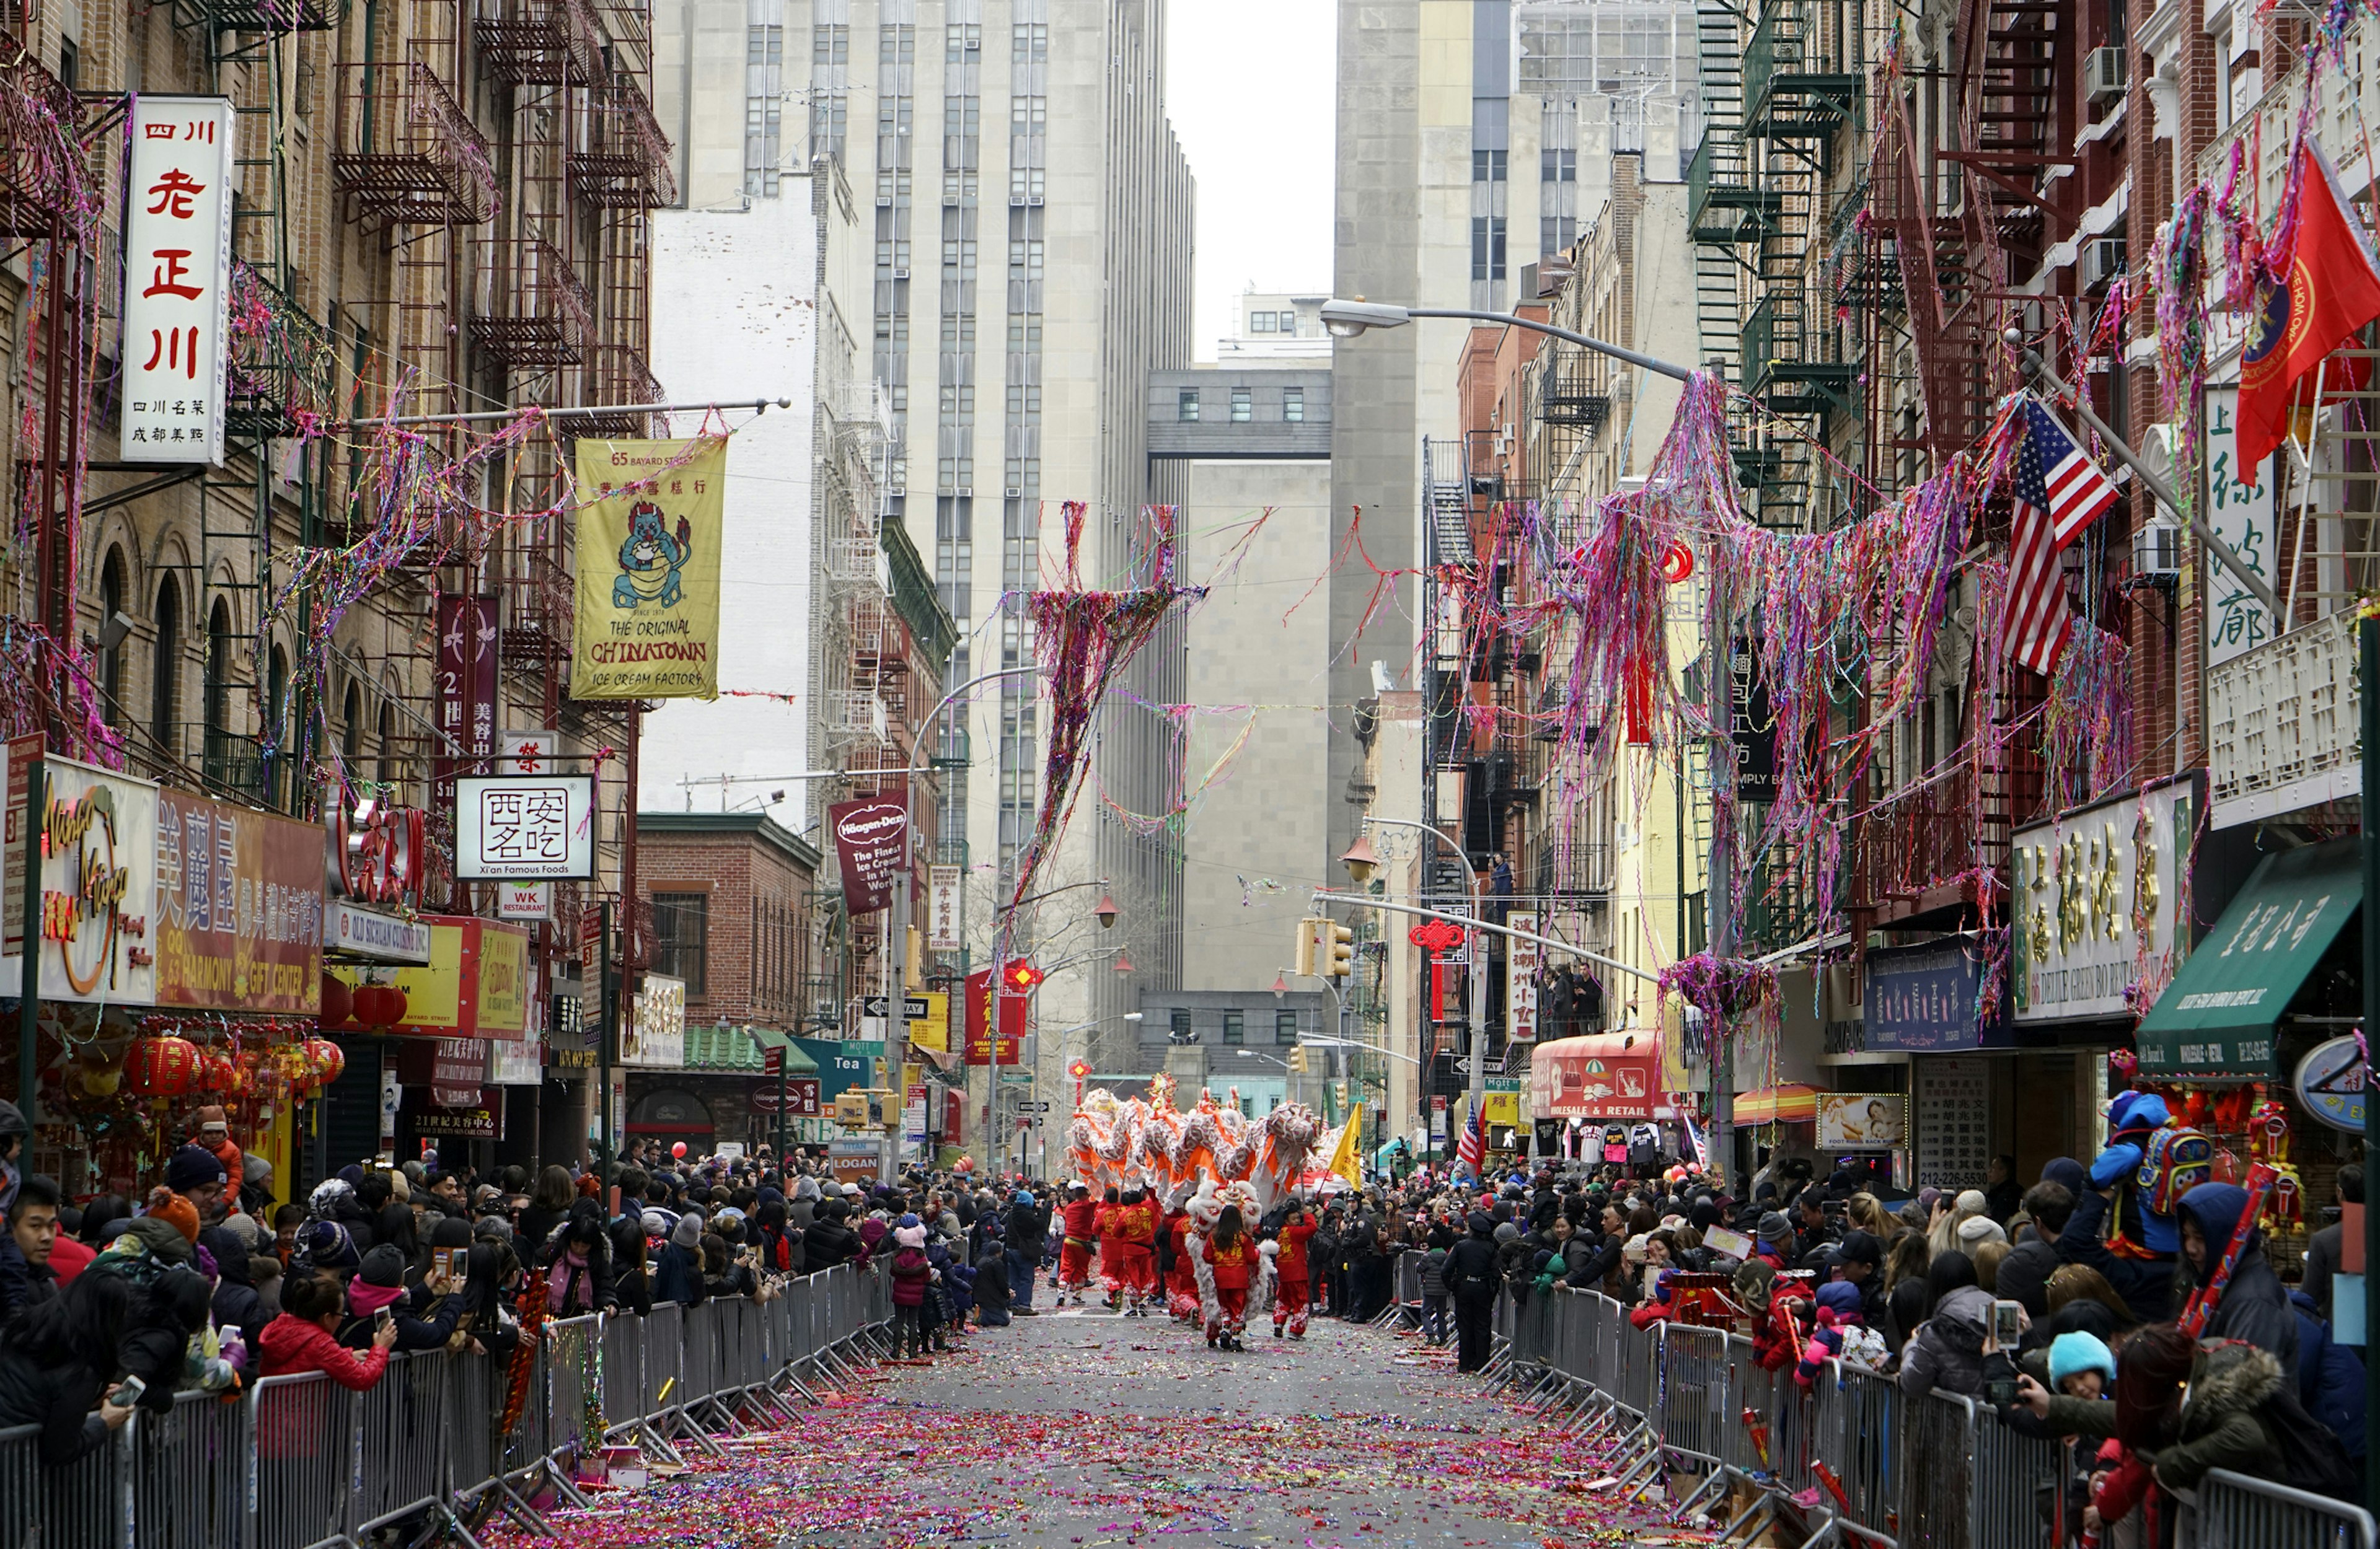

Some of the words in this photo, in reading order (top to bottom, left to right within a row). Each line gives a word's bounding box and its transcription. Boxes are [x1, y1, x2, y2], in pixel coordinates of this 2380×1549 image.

[145, 121, 214, 145] 四川
[221, 175, 230, 271] SICHUAN
[143, 167, 206, 380] 老正川
[218, 290, 226, 386] CUISINE
[133, 400, 205, 416] 四川名菜
[132, 426, 204, 443] 成都美點
[612, 452, 628, 466] 65
[630, 457, 663, 466] BAYARD
[611, 620, 631, 636] THE
[637, 619, 690, 636] ORIGINAL
[591, 641, 707, 663] CHINATOWN
[593, 674, 609, 686] ICE
[614, 674, 651, 686] CREAM
[655, 673, 703, 686] FACTORY
[487, 791, 564, 825] 西安
[842, 814, 904, 835] Häagen-Dazs
[487, 825, 564, 859] 名吃
[853, 851, 871, 862] The
[874, 843, 901, 858] Finest
[480, 865, 503, 874] Xi'an
[505, 865, 539, 874] Famous
[542, 865, 569, 874] Foods
[857, 863, 870, 872] Ice
[873, 855, 901, 869] Cream
[867, 871, 877, 880] in
[868, 880, 892, 891] Worl
[514, 892, 537, 904] WK
[503, 903, 546, 913] RESTAURANT
[352, 915, 364, 942] OLD
[366, 918, 391, 947] SICHUAN
[182, 953, 232, 992] HARMONY
[250, 960, 269, 994] GIFT
[273, 963, 302, 997] CENTER
[2040, 969, 2069, 1004] DELUXE
[2071, 965, 2095, 1001] GREEN
[2096, 963, 2108, 999] BO
[849, 1042, 870, 1050] MOTT
[834, 1057, 860, 1070] Tea
[1593, 1107, 1600, 1116] &
[1606, 1107, 1647, 1117] RETAIL
[2324, 1095, 2345, 1114] #1
[834, 1159, 877, 1169] LOGAN
[1920, 1172, 1988, 1185] 212-226-5530
